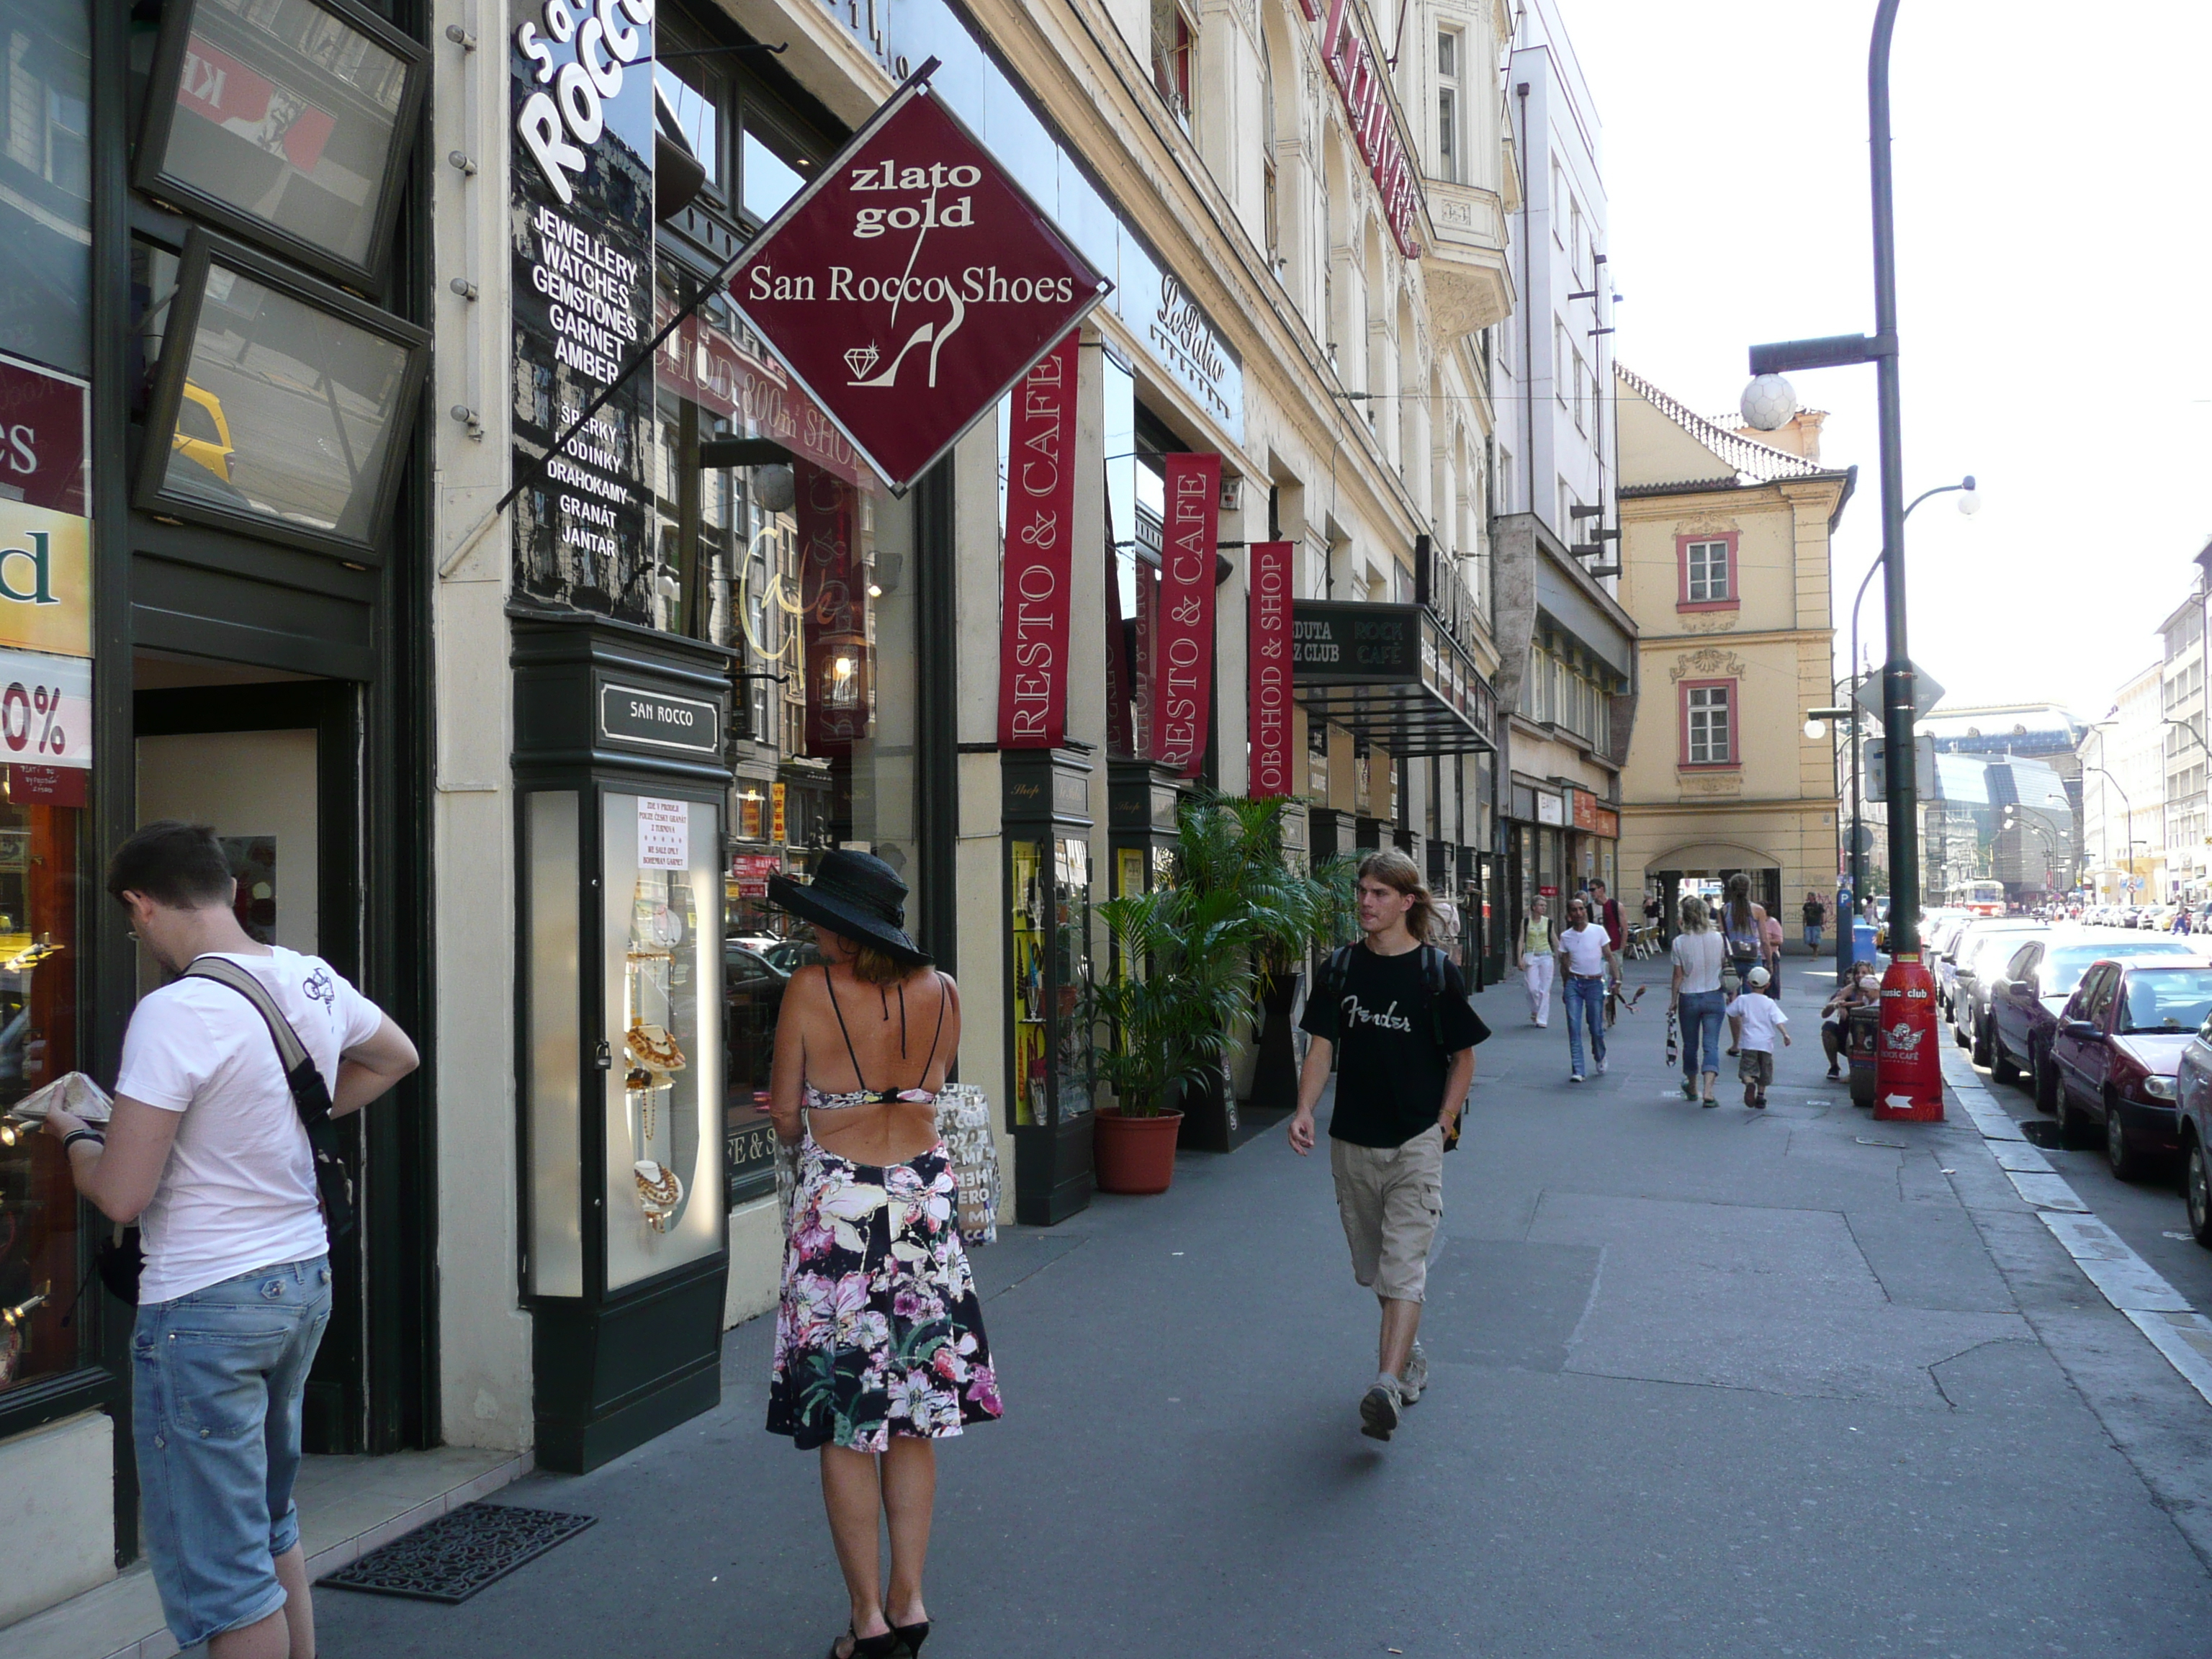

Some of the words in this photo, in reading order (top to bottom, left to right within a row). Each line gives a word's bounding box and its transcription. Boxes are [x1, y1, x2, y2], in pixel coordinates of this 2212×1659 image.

[850, 159, 981, 191] zlato
[853, 196, 975, 238] gold
[534, 205, 637, 285] JEWELLERY
[541, 237, 630, 310] WATCHES
[749, 265, 817, 301] San
[827, 266, 945, 302] Rocco
[961, 266, 1073, 303] Shoes
[532, 265, 637, 341] GEMSTONES
[549, 304, 624, 361] GARNET
[554, 336, 619, 385] AMBER
[1149, 323, 1231, 419] LIFESTYLE
[1022, 354, 1062, 498] CAFE
[547, 459, 627, 505] DRAHOKAMY
[559, 494, 617, 529] GRANÁT
[1020, 509, 1057, 549] &
[1172, 472, 1208, 585] CAFE
[562, 525, 616, 557] JANTAR
[1171, 595, 1202, 626] &
[1261, 553, 1282, 631] SHOP
[1012, 565, 1056, 742] RESTO
[1261, 637, 1282, 660] &
[1304, 643, 1340, 662] CLUB
[630, 701, 654, 721] SAN
[657, 703, 693, 727] ROCCO
[1261, 665, 1282, 789] OBCHOD
[1010, 783, 1041, 799] Shop
[1341, 994, 1411, 1033] Fender
[1907, 988, 1928, 999] club
[750, 1132, 763, 1159] &
